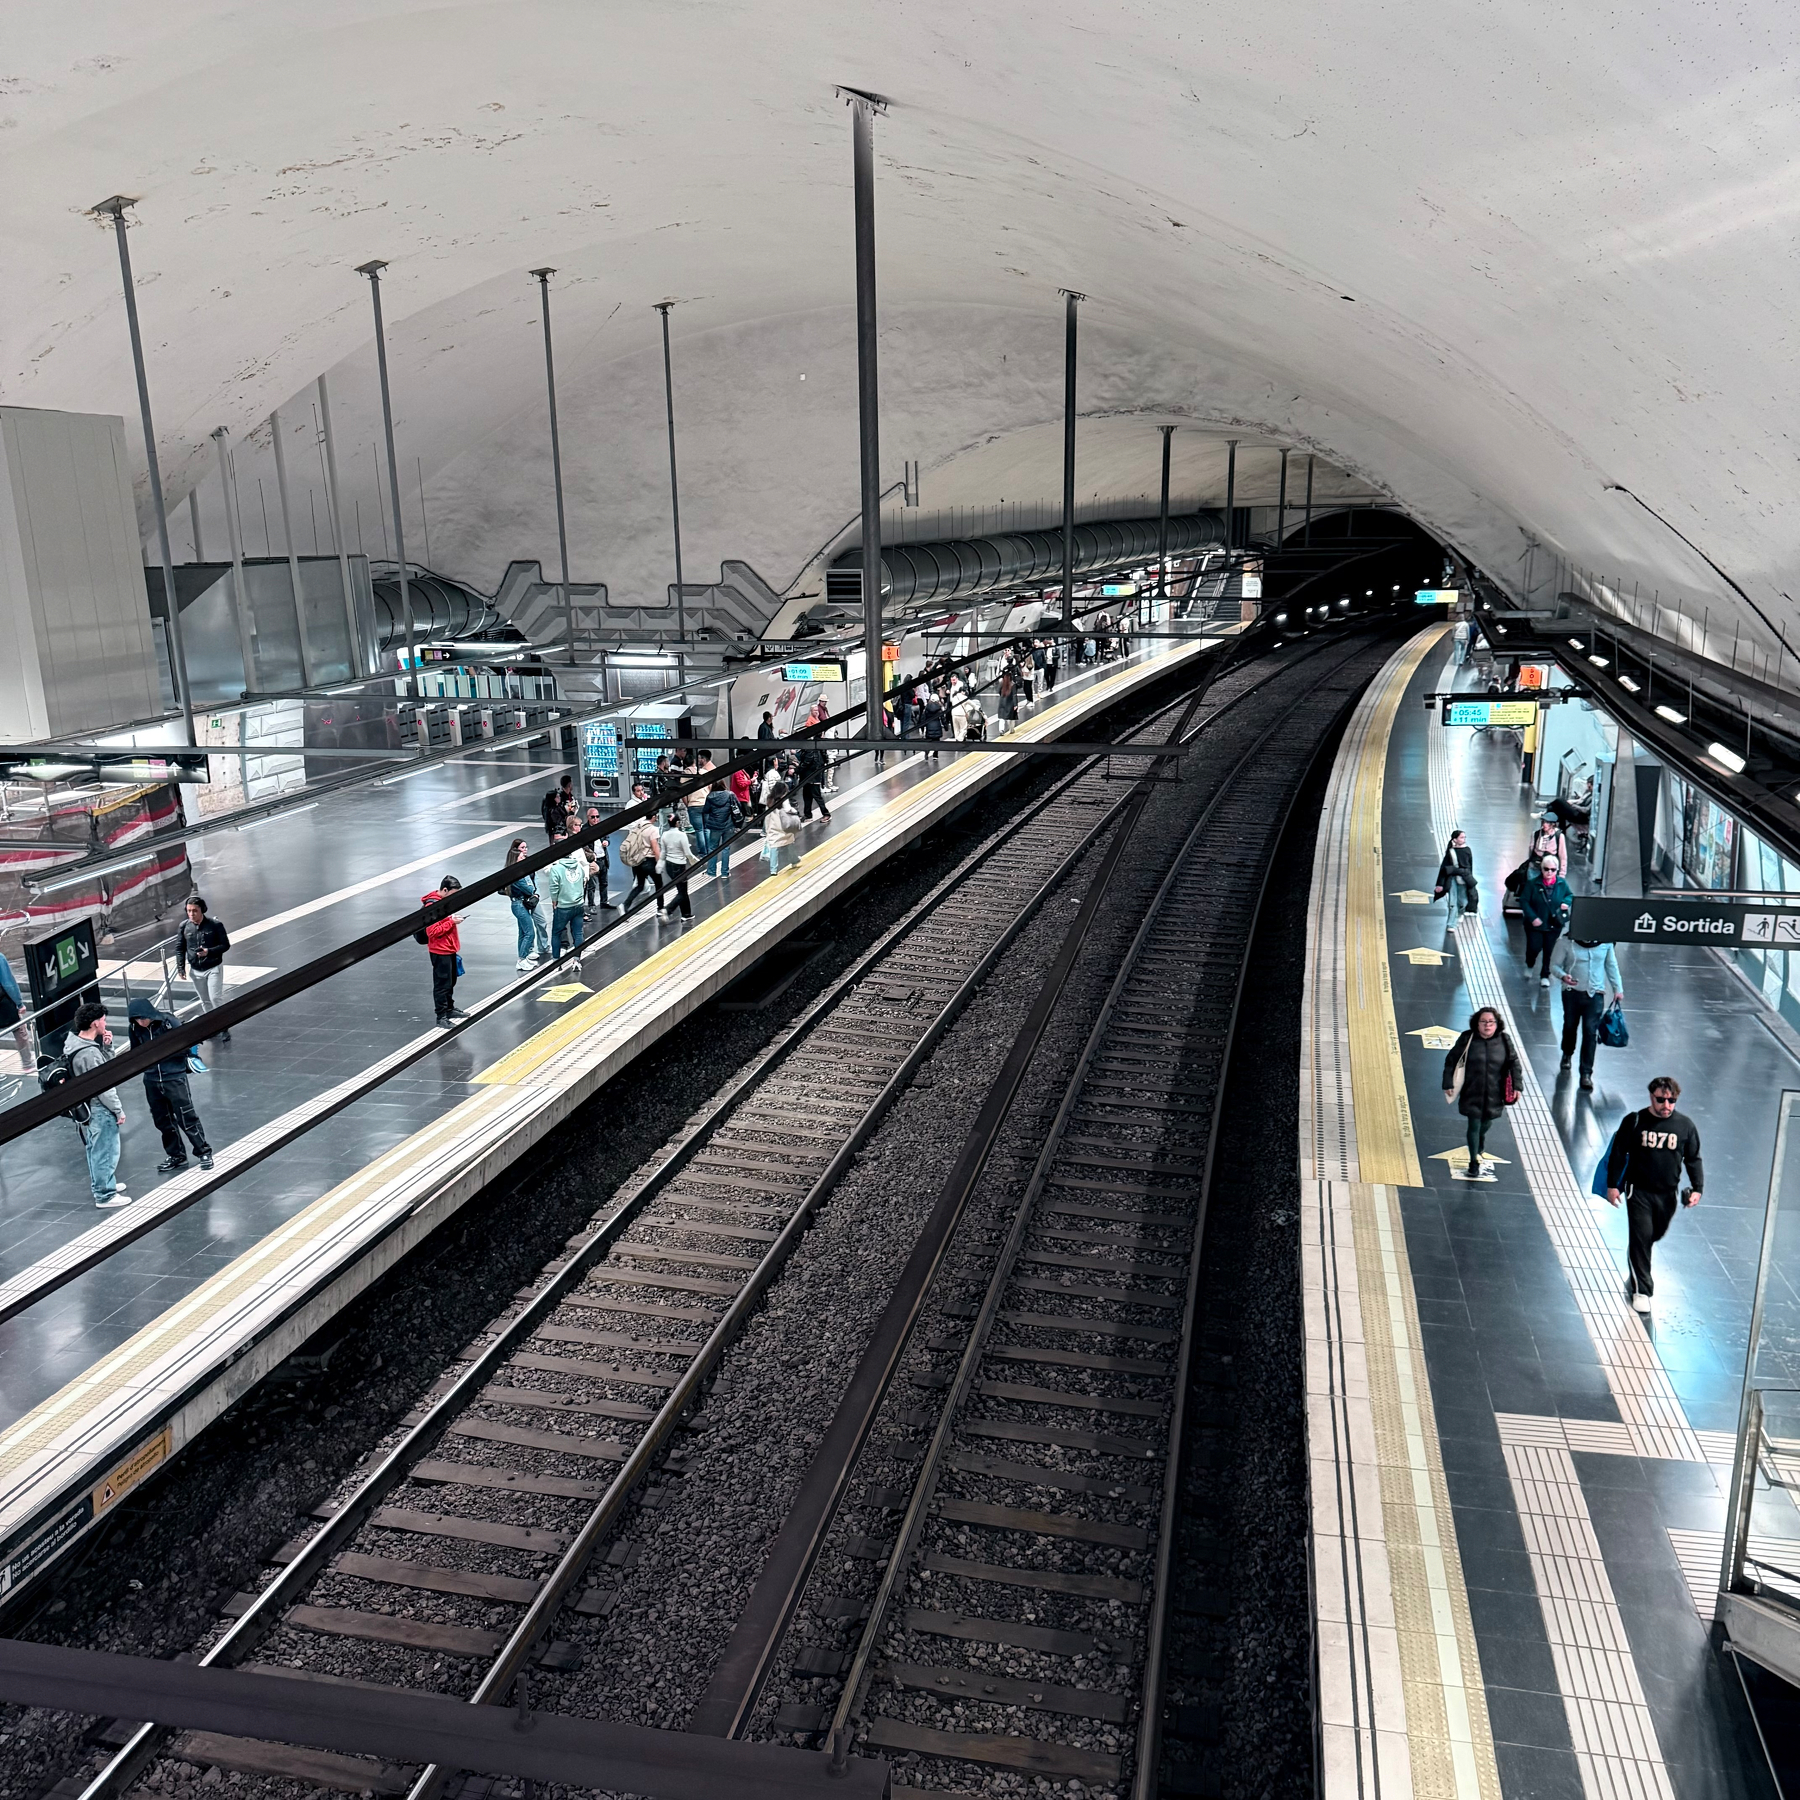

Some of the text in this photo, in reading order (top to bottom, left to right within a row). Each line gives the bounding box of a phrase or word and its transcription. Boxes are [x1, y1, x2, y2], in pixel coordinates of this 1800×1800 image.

[1662, 915, 1735, 935] Sortida
[58, 945, 76, 970] L3
[1641, 1130, 1678, 1150] 1978
[12, 1561, 21, 1571] No
[21, 1554, 30, 1563] us
[30, 1533, 54, 1556] acosteu
[59, 1524, 65, 1532] la
[65, 1507, 85, 1526] vorada
[12, 1521, 78, 1580] No acercarse al bordillo
